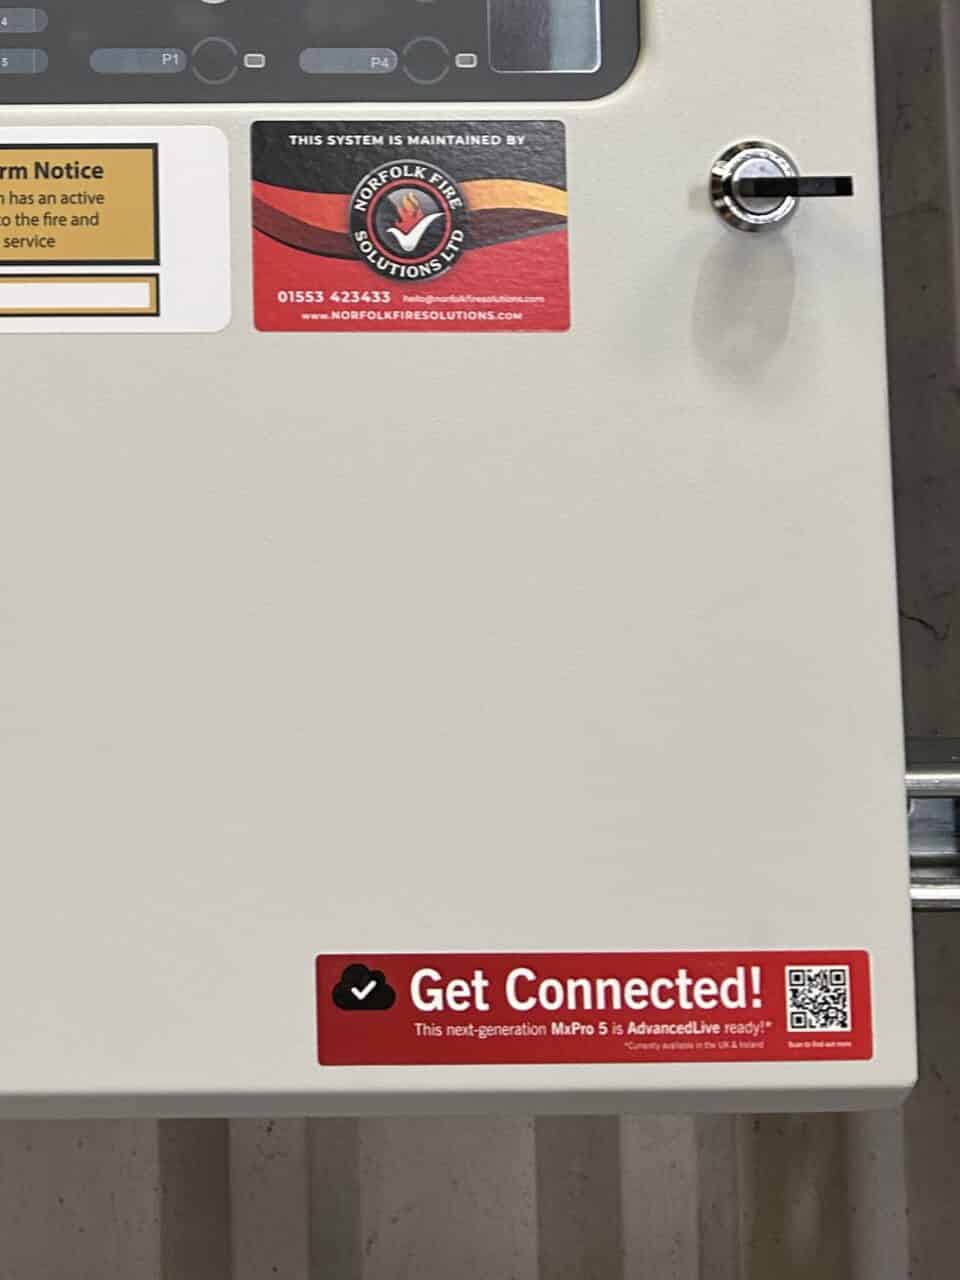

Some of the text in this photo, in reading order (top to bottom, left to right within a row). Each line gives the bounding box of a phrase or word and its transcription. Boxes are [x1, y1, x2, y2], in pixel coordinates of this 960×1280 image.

[0, 17, 8, 27] 4
[0, 57, 9, 68] 5
[162, 53, 179, 65] P1
[370, 56, 390, 68] P4
[288, 135, 526, 145] THIS SYSTEM IS MAINTAINED BY
[34, 161, 104, 180] Notice
[355, 166, 464, 212] NORFOLK FIRE
[9, 191, 34, 204] has
[38, 193, 56, 204] an
[60, 191, 105, 204] active
[15, 212, 39, 226] the
[43, 212, 67, 226] fire
[70, 212, 100, 226] and
[4, 235, 56, 248] service
[355, 229, 465, 278] SOLUTIONS LTD
[277, 291, 391, 303] 01553 423433
[410, 966, 762, 1011] Get Connected!
[414, 1022, 442, 1036] This
[446, 1021, 547, 1039] next-generation
[551, 1021, 595, 1035] MxPro
[598, 1021, 608, 1035] 5
[612, 1022, 624, 1035] is
[627, 1020, 720, 1035] AdvancedLive
